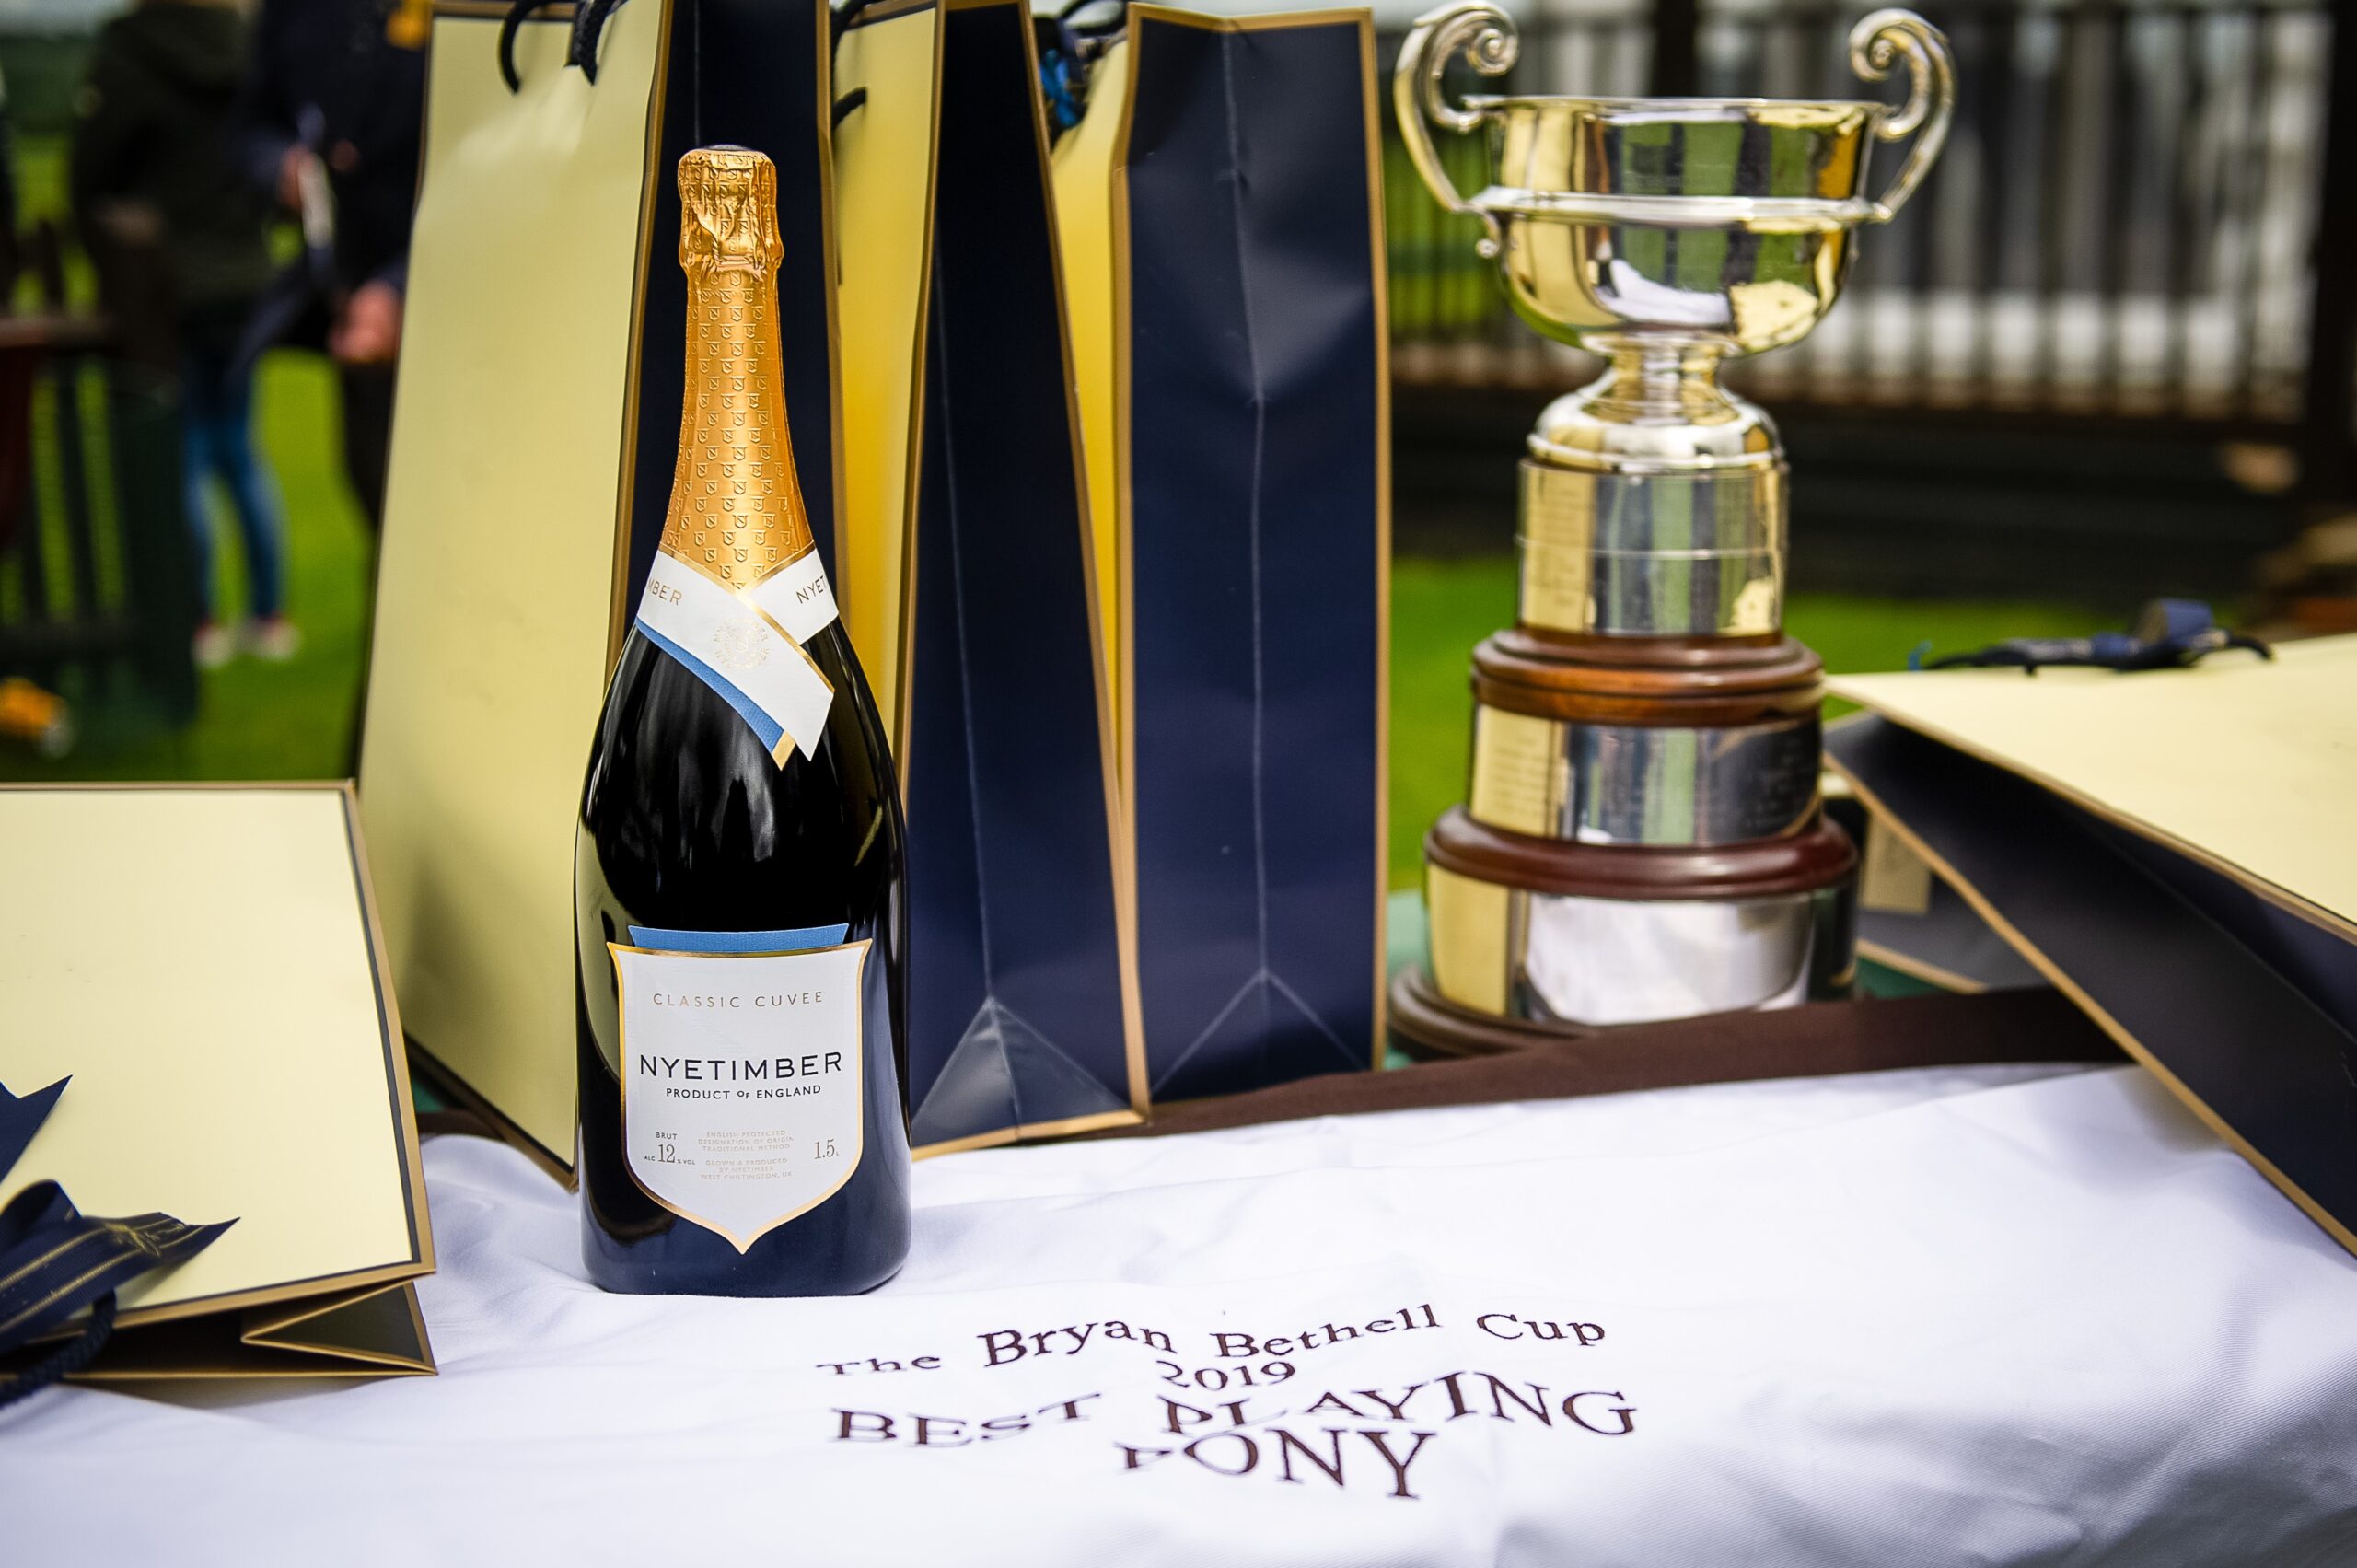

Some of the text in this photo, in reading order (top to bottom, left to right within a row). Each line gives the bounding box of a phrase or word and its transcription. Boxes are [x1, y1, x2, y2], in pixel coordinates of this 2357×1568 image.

[653, 991, 824, 1008] CLASSIC CUVEE
[640, 1051, 842, 1081] NYETIMBER
[666, 1087, 731, 1099] PRODUCT
[756, 1085, 821, 1099] ENGLAND
[656, 1132, 678, 1140] BRUT
[741, 1130, 786, 1138] PROTECTED
[657, 1144, 676, 1164] 12
[758, 1143, 790, 1151] METHOD
[746, 1157, 787, 1166] PRODUCED
[815, 1304, 1606, 1376] The Bryan Bethell Cup
[1156, 1361, 1296, 1391] 2019
[828, 1370, 1638, 1449] BEST PLAYING
[1113, 1427, 1437, 1502] PONY
